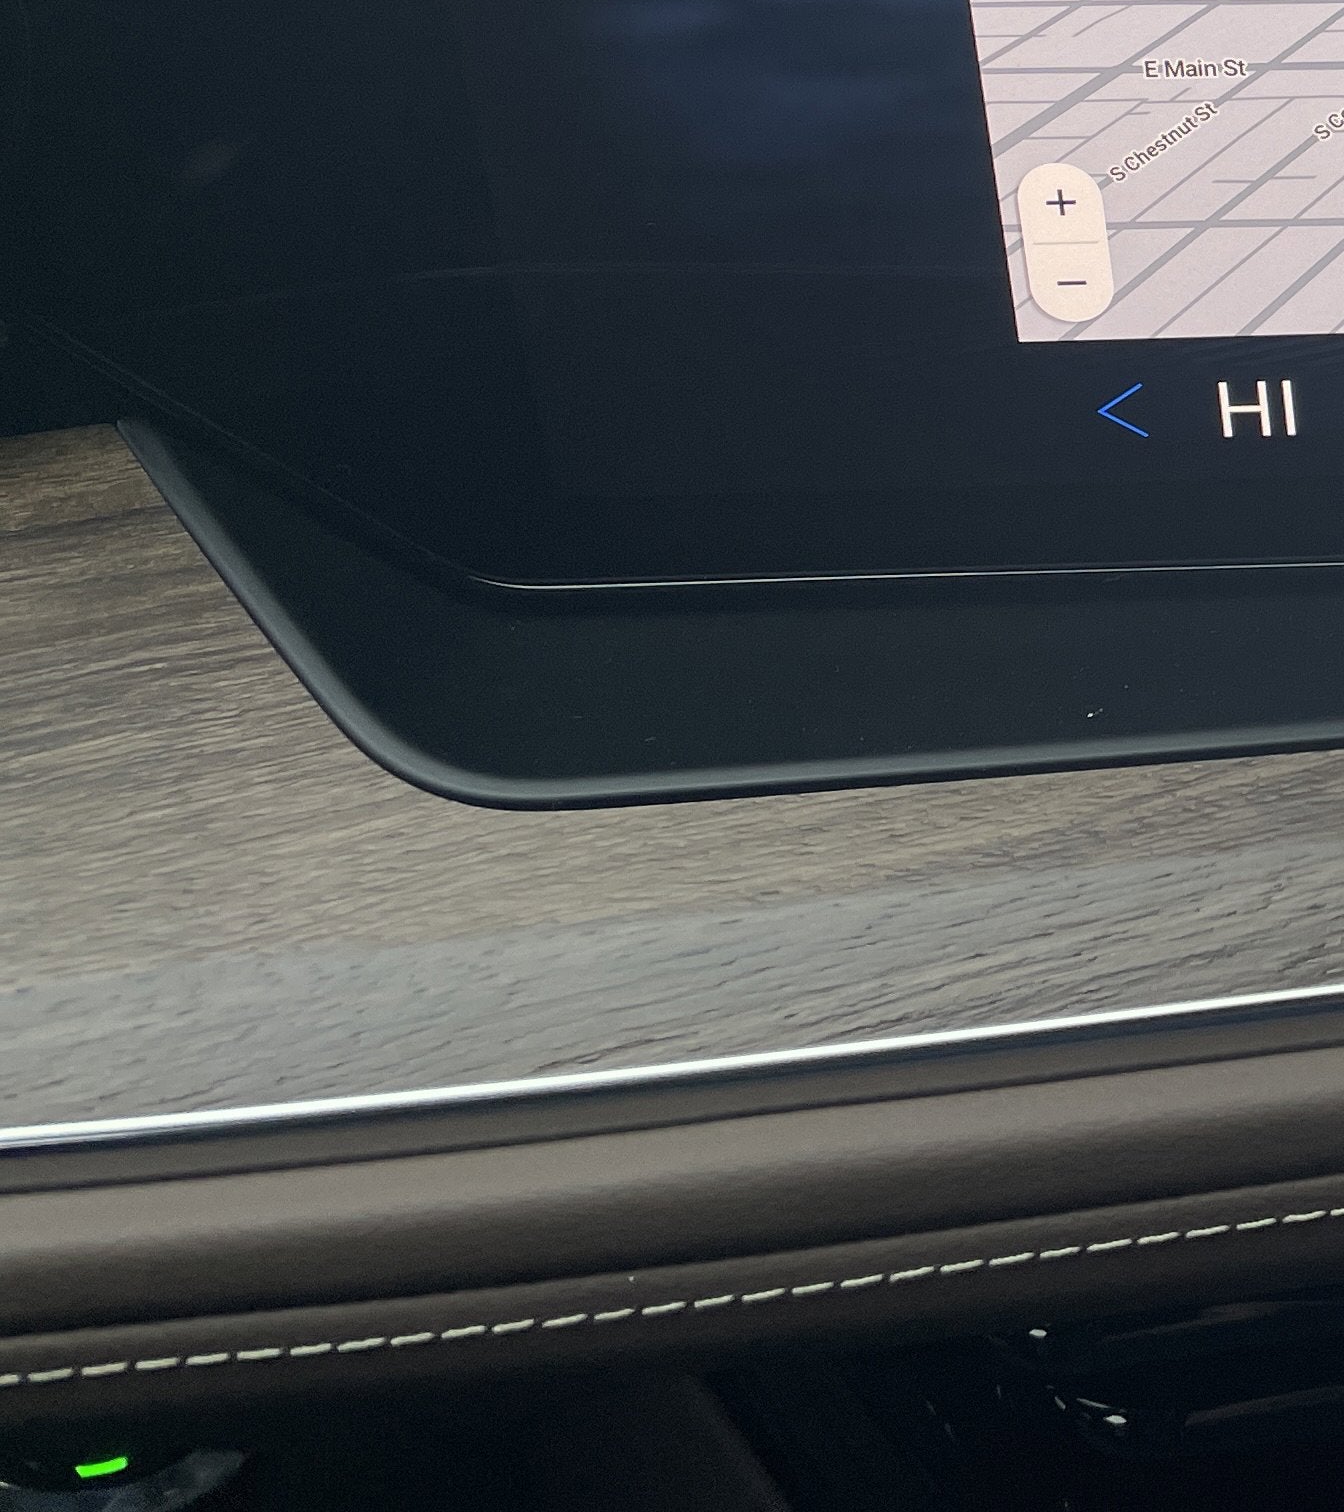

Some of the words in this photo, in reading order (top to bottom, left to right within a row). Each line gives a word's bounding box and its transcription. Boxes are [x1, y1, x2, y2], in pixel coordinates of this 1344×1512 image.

[1144, 61, 1157, 78] E
[1165, 59, 1218, 78] Main
[1223, 59, 1247, 77] St
[1110, 166, 1126, 183] S
[1125, 117, 1197, 173] Chestnut
[1194, 102, 1218, 123] St
[1314, 124, 1331, 140] S
[1218, 379, 1297, 438] HI
